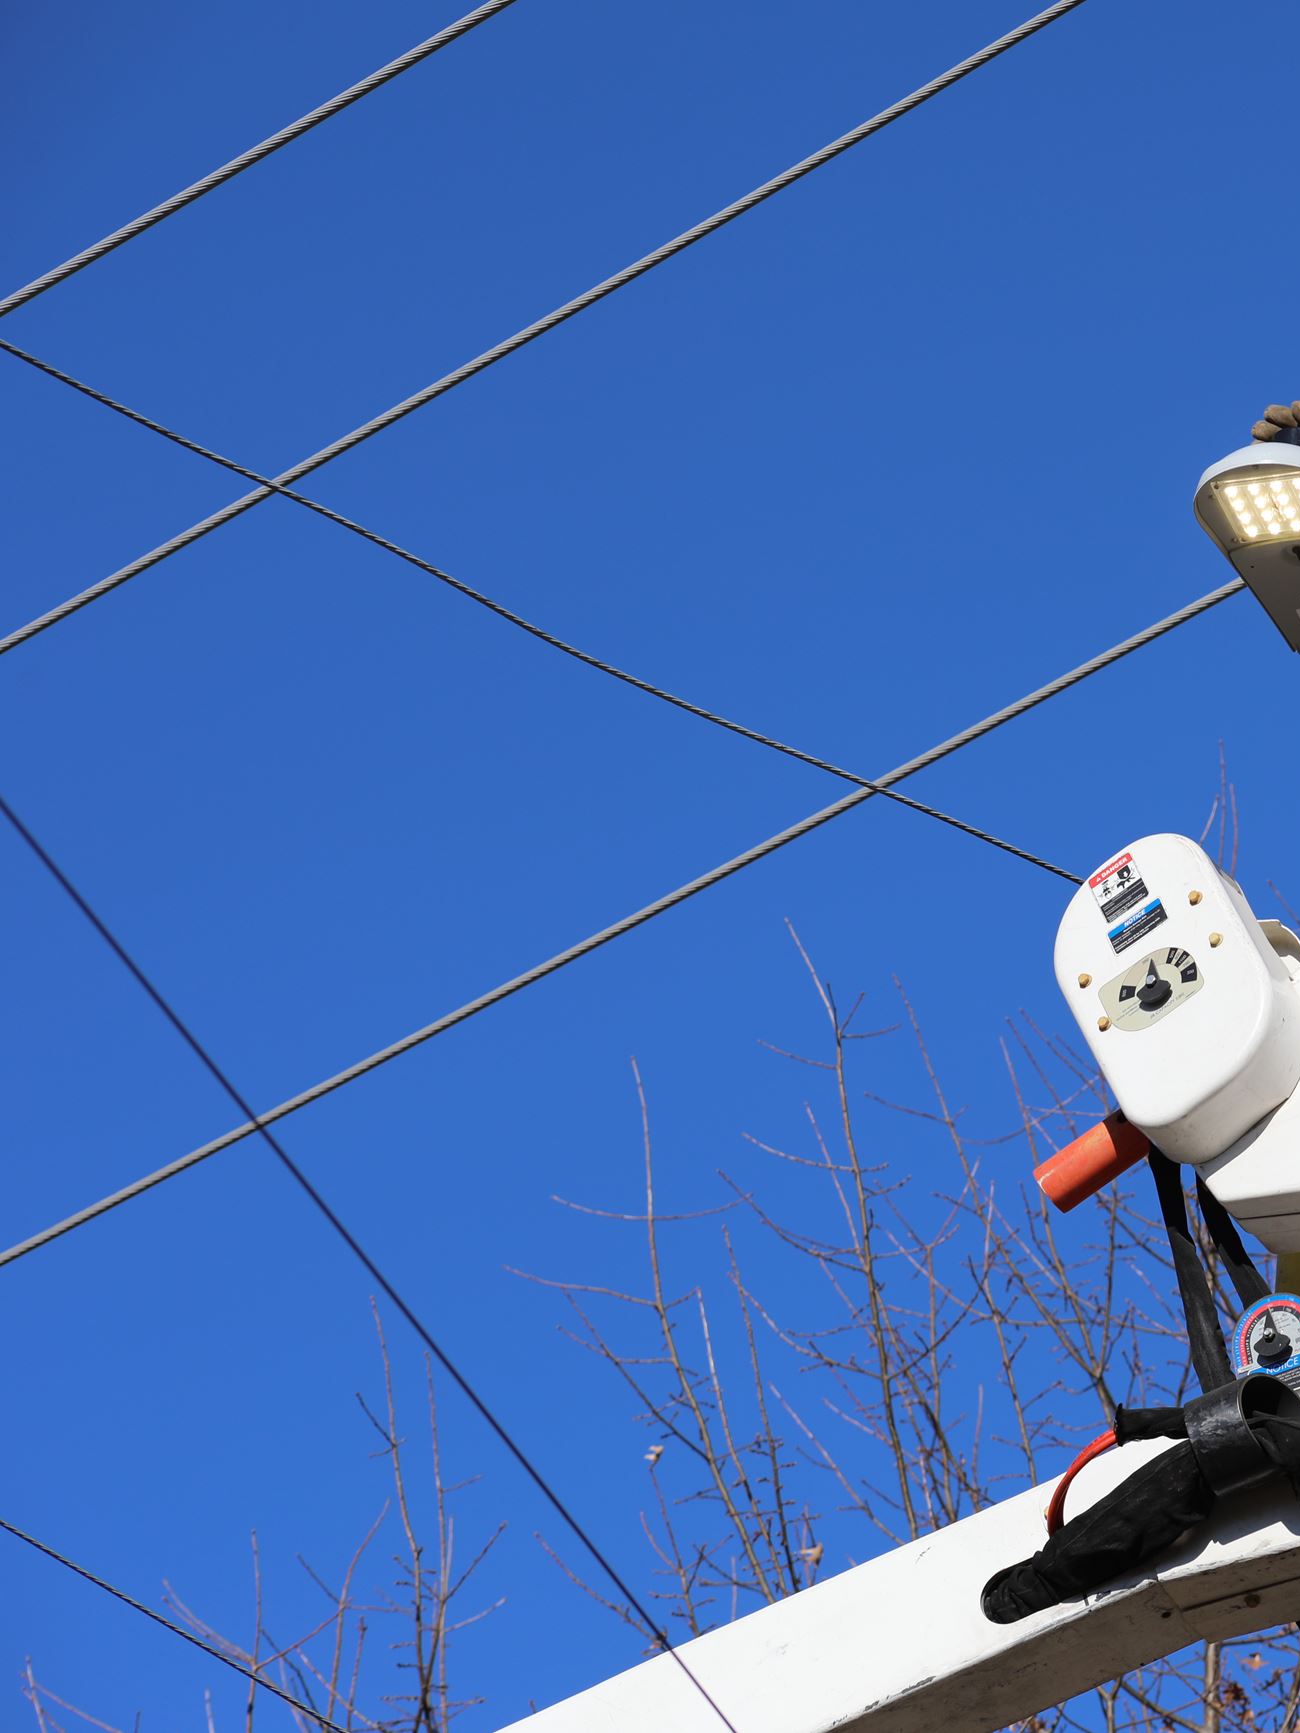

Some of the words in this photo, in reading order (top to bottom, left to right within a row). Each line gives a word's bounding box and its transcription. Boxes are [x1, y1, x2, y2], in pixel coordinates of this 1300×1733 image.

[1101, 857, 1129, 878] DANGER
[1123, 909, 1147, 928] NOTICE
[1266, 1356, 1299, 1374] NOTICE
